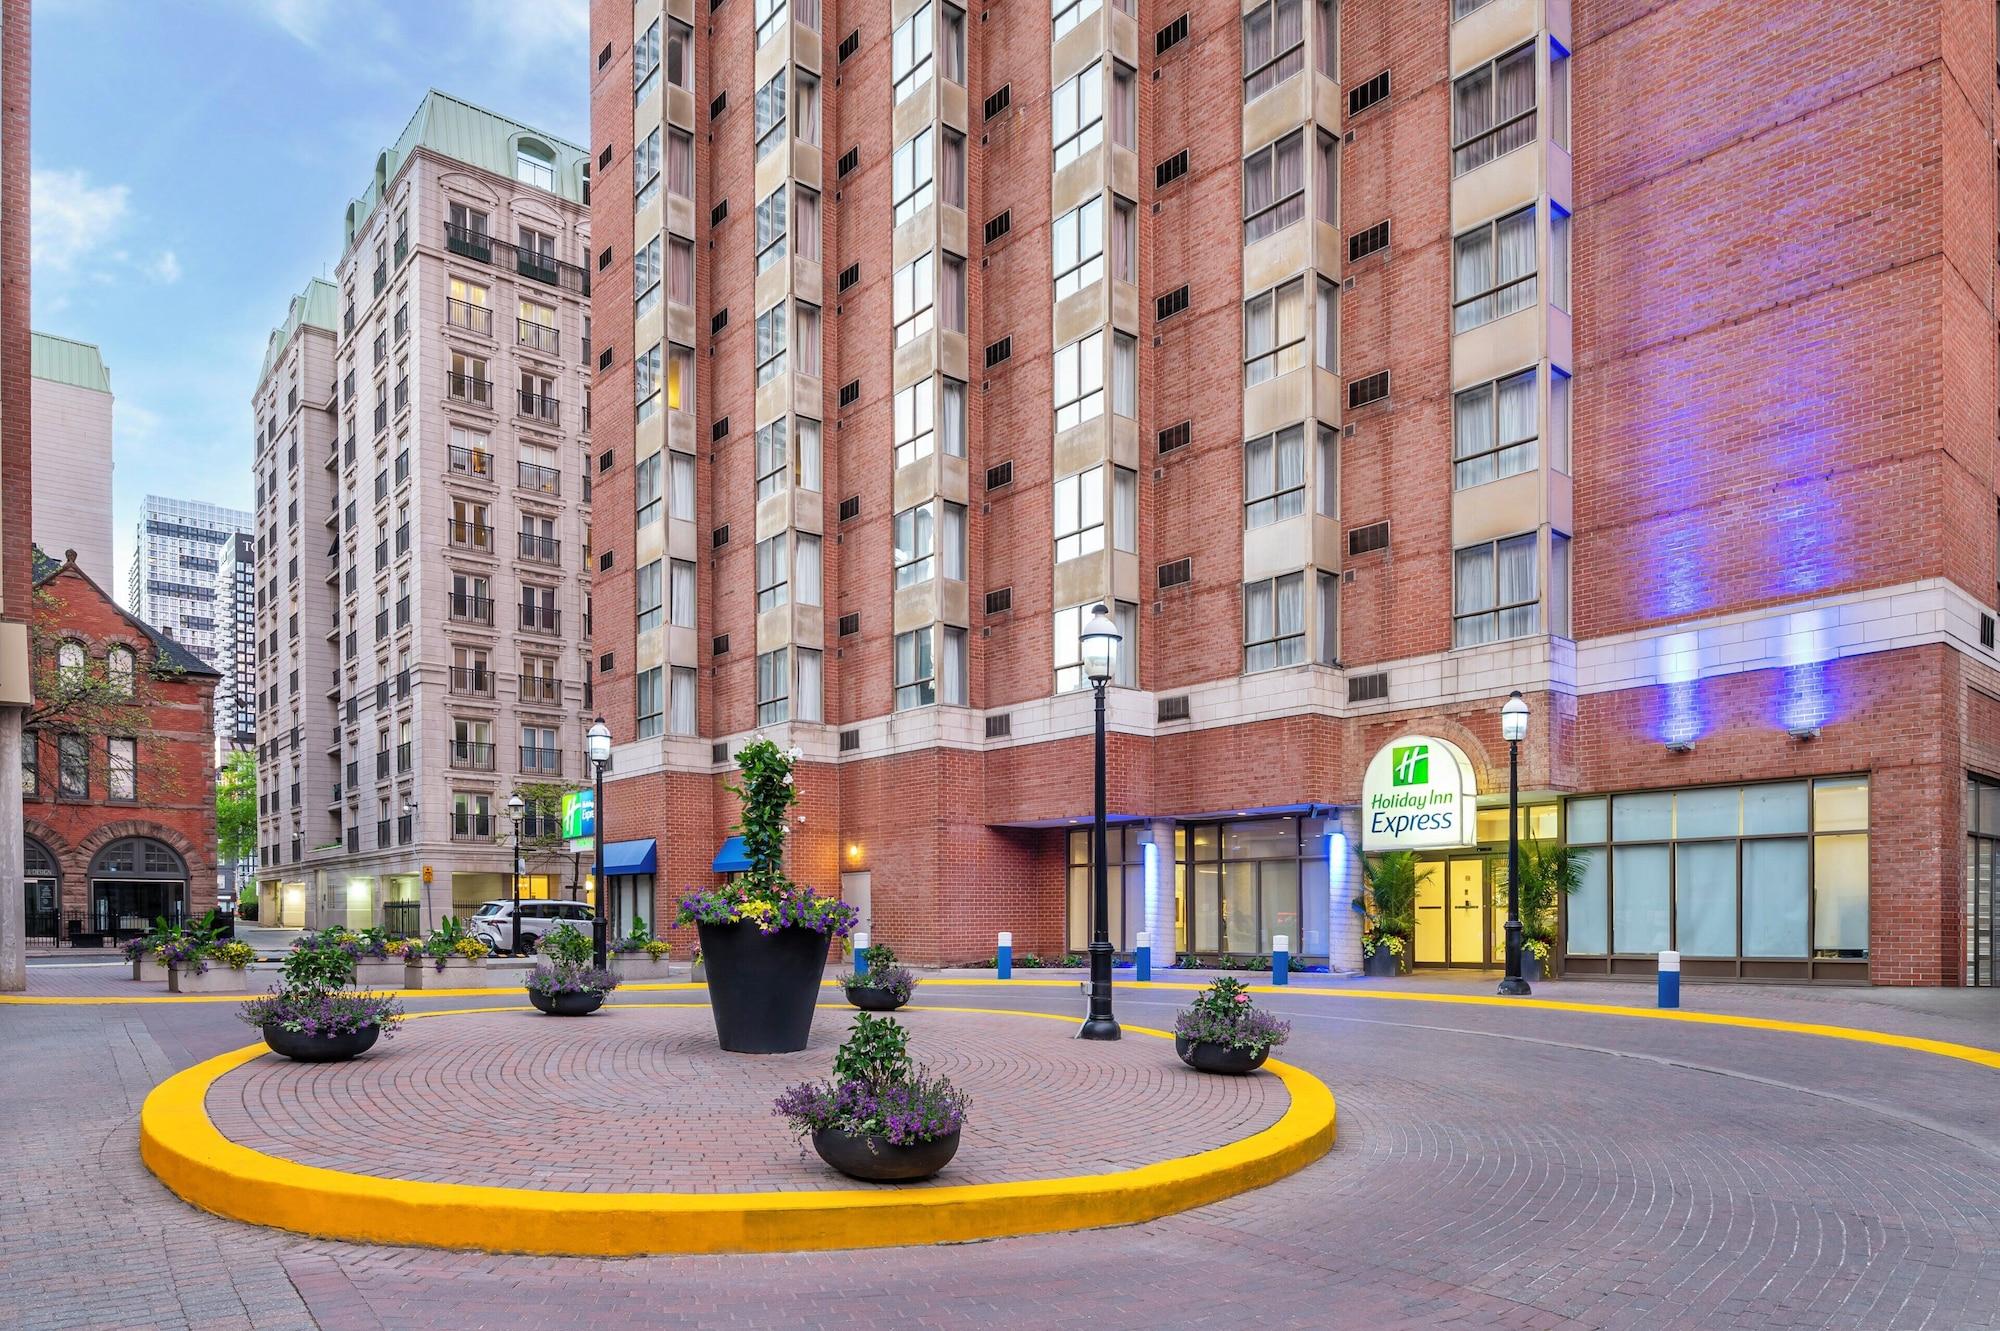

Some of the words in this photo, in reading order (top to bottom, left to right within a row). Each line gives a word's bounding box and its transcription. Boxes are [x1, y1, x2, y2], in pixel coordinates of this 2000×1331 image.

[1371, 791, 1428, 810] Holiday
[1429, 789, 1453, 805] Inn
[1371, 811, 1453, 838] Express
